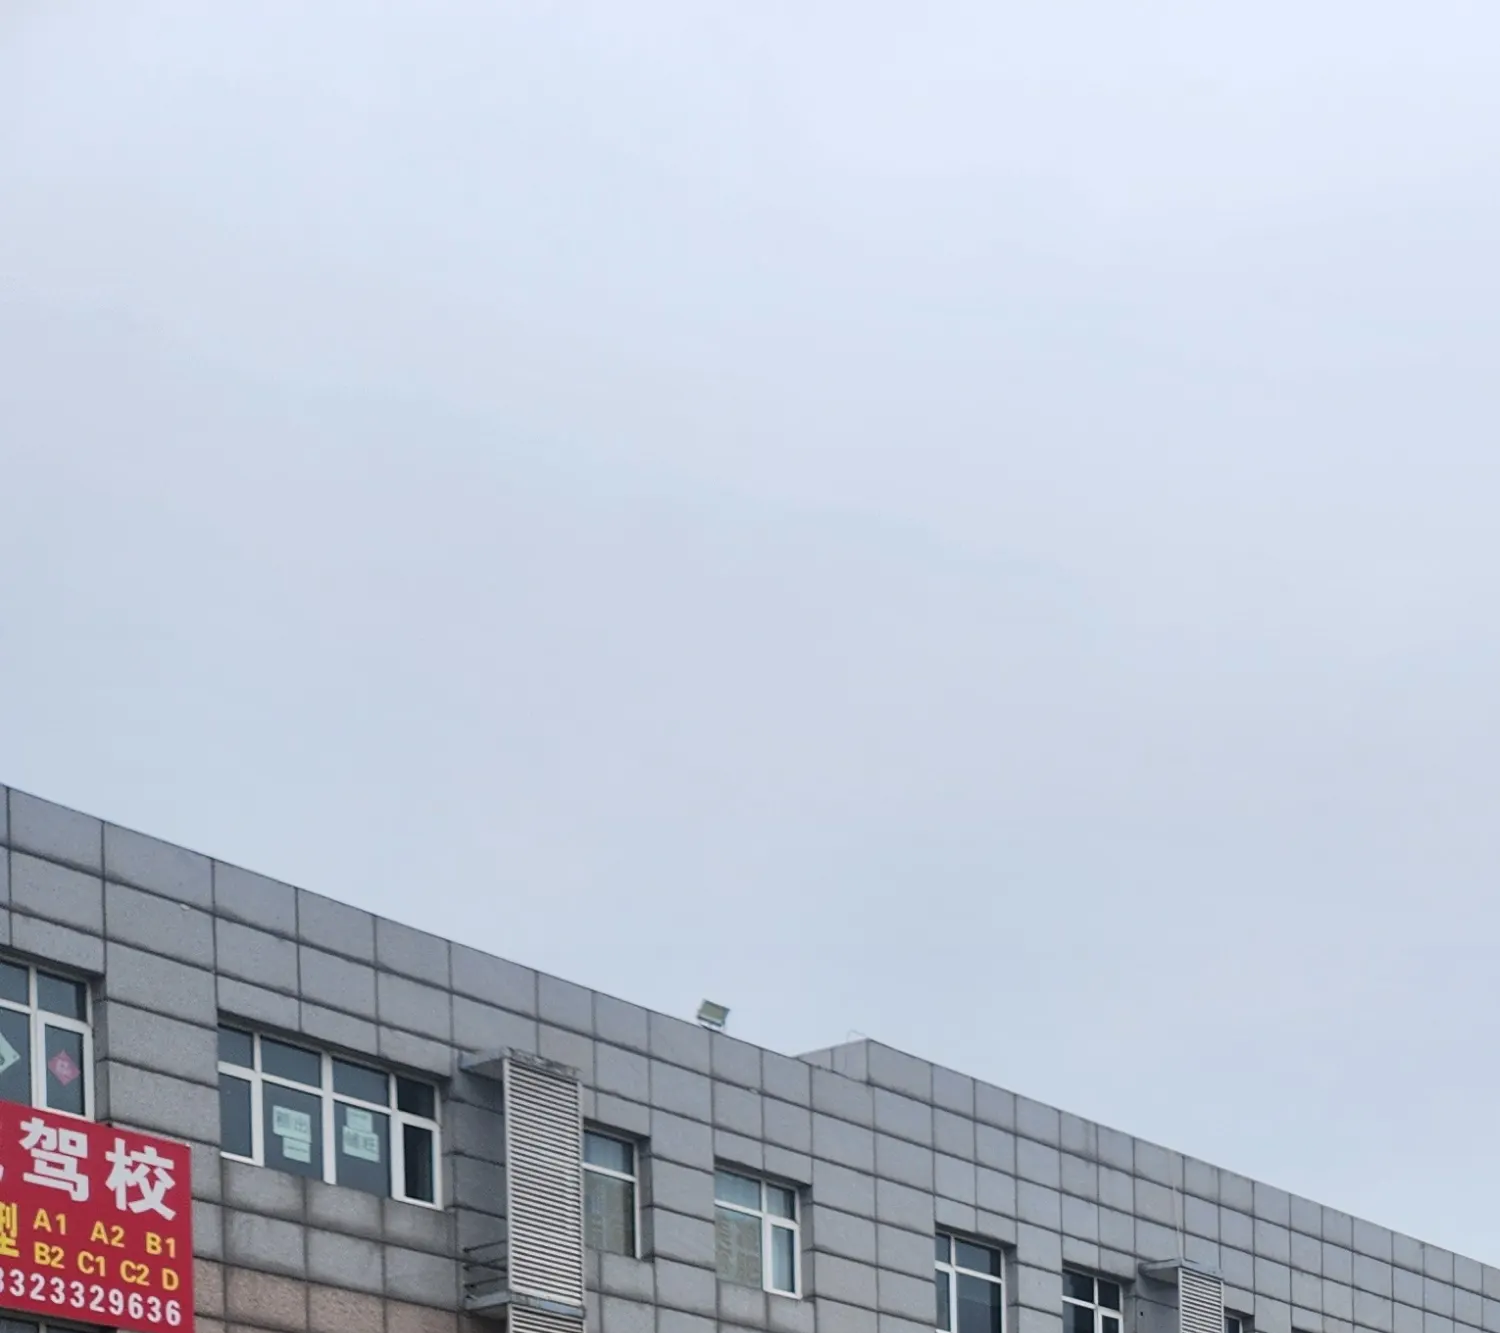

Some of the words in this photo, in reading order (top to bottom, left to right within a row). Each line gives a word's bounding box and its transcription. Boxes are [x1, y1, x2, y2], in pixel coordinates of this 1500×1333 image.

[19, 1117, 176, 1221] 驾校
[33, 1208, 67, 1235] A1
[91, 1221, 125, 1248] A2
[145, 1232, 176, 1259] B1
[33, 1242, 65, 1269] B2
[77, 1251, 107, 1278] C1
[120, 1260, 150, 1287] C2
[162, 1268, 180, 1291] D
